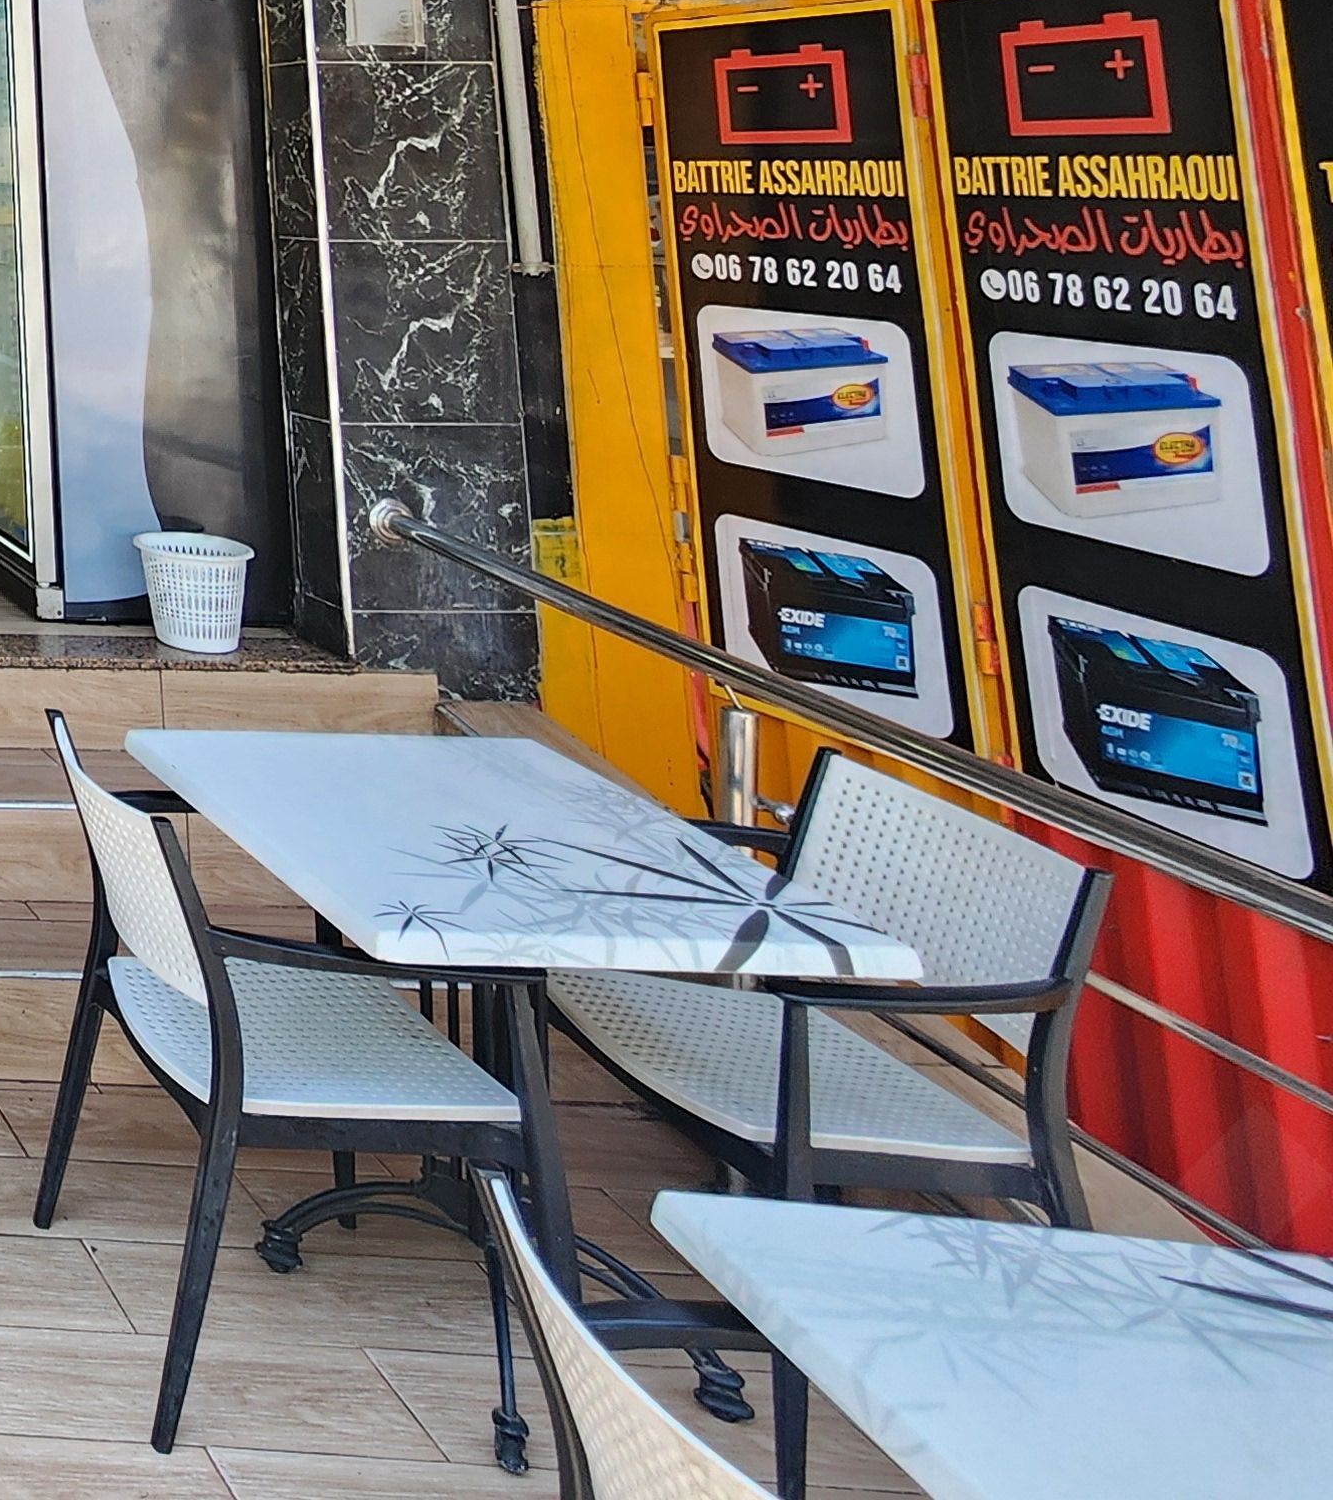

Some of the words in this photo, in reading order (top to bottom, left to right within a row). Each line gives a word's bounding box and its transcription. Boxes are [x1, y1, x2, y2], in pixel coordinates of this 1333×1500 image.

[673, 159, 755, 195] BATTRIE
[759, 159, 906, 198] ASSAHRAOUI
[953, 155, 1054, 198] BATTRIE
[1058, 154, 1240, 201] ASSAHRAOUI
[679, 201, 804, 244] الصحراوي
[808, 203, 910, 252] بطاريات
[964, 205, 1115, 257] الصحراوي
[1118, 208, 1244, 269] بطاريات
[713, 253, 742, 282] 06
[747, 255, 779, 284] 78
[785, 257, 818, 288] 62
[825, 259, 859, 291] 20
[867, 262, 903, 294] 64
[1007, 269, 1041, 303] 06
[1047, 271, 1084, 308] 78
[1093, 275, 1132, 312] 62
[1141, 278, 1182, 317] 20
[1193, 281, 1237, 321] 64
[778, 607, 826, 628] EXIDE
[1096, 703, 1153, 732] EXIDE
